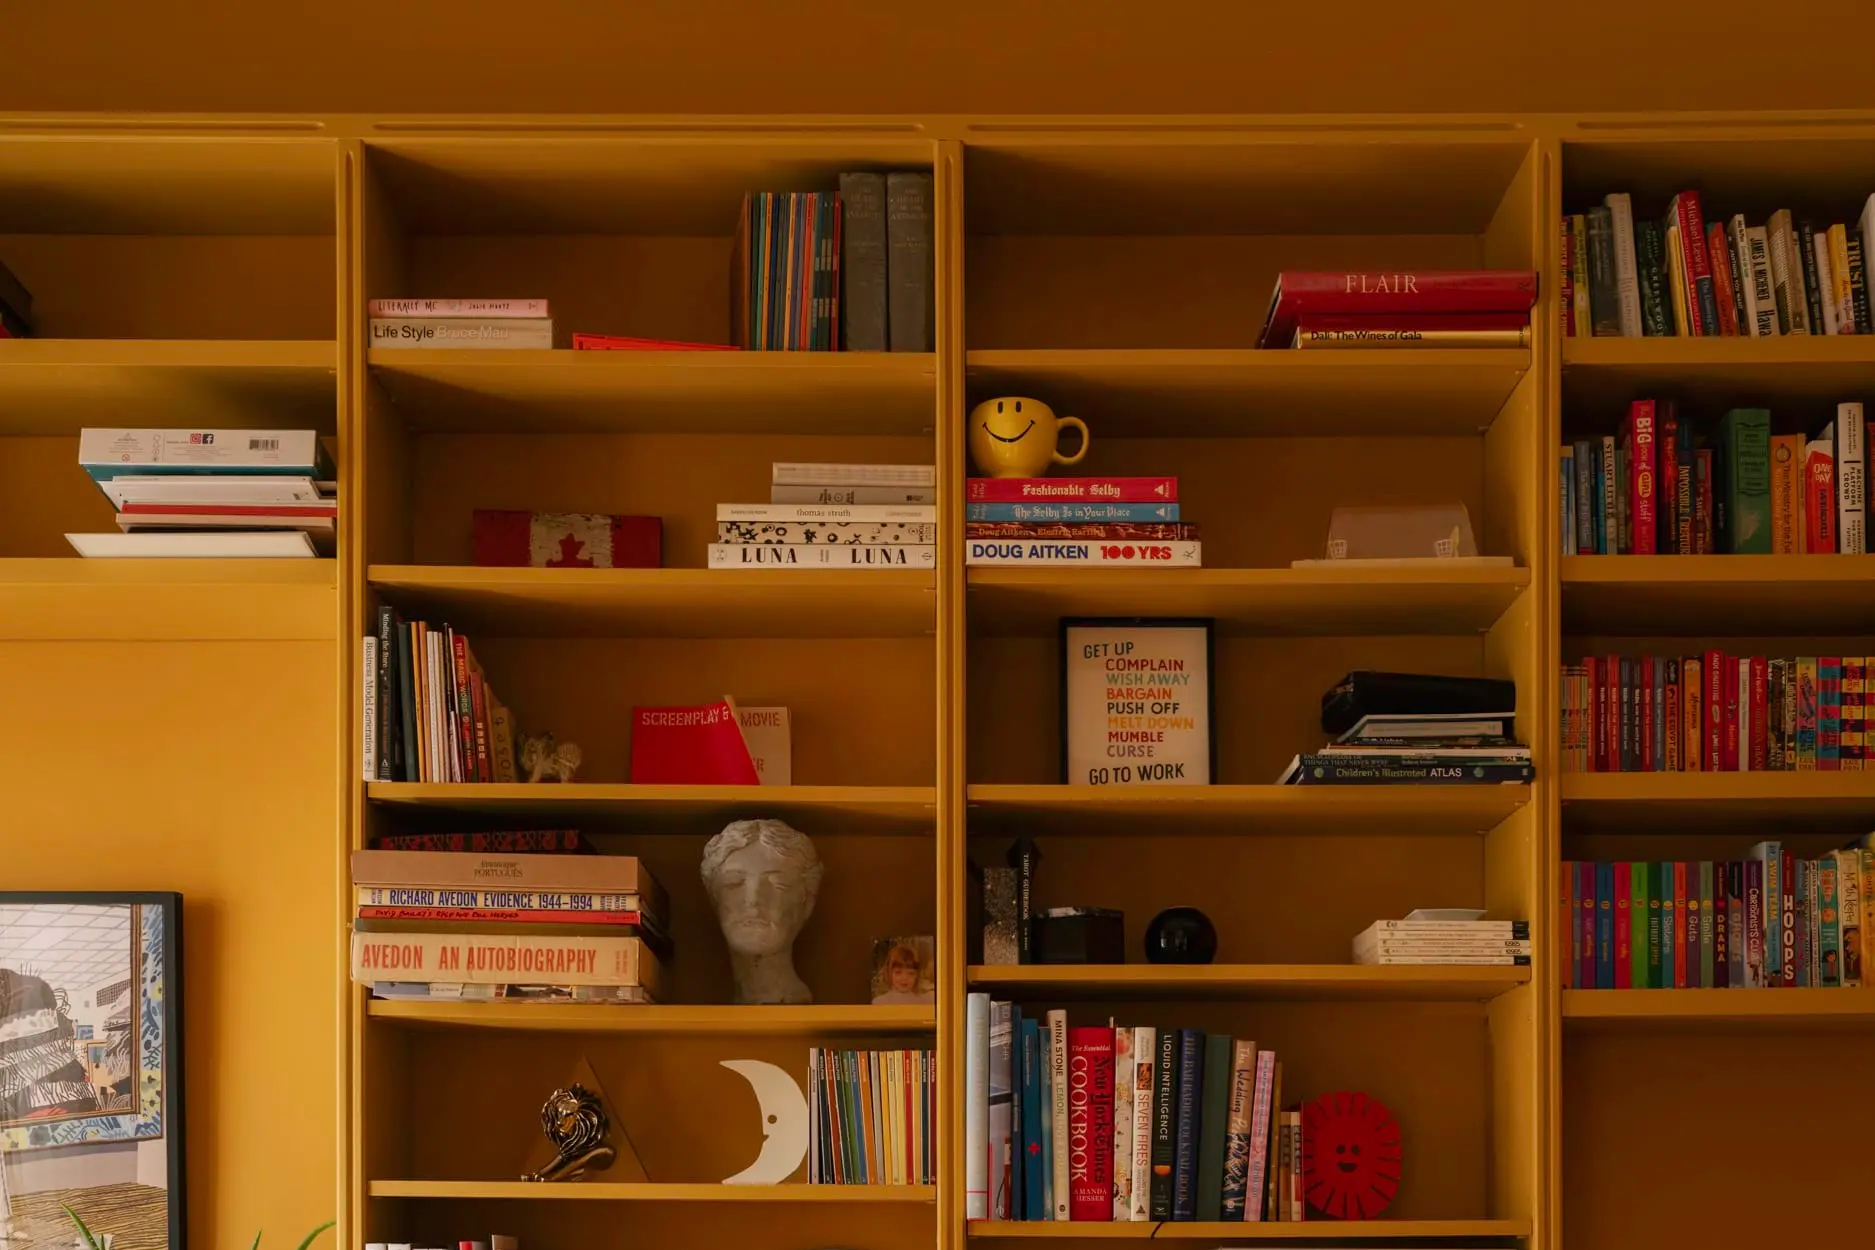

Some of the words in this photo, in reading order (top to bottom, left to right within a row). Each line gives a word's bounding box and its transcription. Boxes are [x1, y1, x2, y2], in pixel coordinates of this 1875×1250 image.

[1686, 199, 1701, 241] Michael
[1750, 238, 1766, 260] JAMES
[1345, 274, 1419, 293] FLAIR
[1754, 269, 1770, 301] MICHENER
[425, 301, 438, 312] ME
[374, 326, 398, 338] Life
[401, 325, 434, 341] Style
[437, 326, 480, 338] Bruce
[1335, 331, 1354, 341] The
[1355, 331, 1386, 341] Wines
[1388, 330, 1398, 341] of
[1400, 331, 1422, 341] Gala
[1605, 443, 1614, 482] STUART
[1022, 483, 1084, 495] Fashionable
[1089, 483, 1120, 499] Selby
[1606, 484, 1616, 516] LITTLE
[1679, 465, 1691, 514] IMPOSSIBLE
[796, 508, 825, 517] thomas
[828, 509, 851, 517] struth
[1012, 506, 1030, 519] The
[1032, 506, 1059, 519] Selby
[1075, 506, 1082, 518] in
[1083, 506, 1105, 519] Your
[1106, 505, 1130, 518] Place
[979, 529, 999, 537] Doug
[1001, 529, 1028, 537] Aitken
[742, 548, 797, 563] LUNA
[851, 548, 907, 564] LUNA
[972, 544, 1022, 559] DOUG
[1028, 545, 1088, 559] AITKEN
[1101, 546, 1135, 559] 100
[1138, 546, 1171, 559] YRS
[380, 613, 390, 640] Minding
[365, 642, 374, 678] Business
[455, 642, 464, 656] THE
[1084, 643, 1109, 659] GET
[1114, 642, 1134, 656] UP
[457, 659, 466, 682] MAGIC
[1105, 658, 1184, 671] COMPLAIN
[1106, 673, 1143, 685] WISH
[1147, 673, 1190, 685] AWAY
[366, 680, 375, 711] Model
[459, 684, 469, 712] WORDS
[1106, 687, 1172, 700] BARGAIN
[641, 707, 720, 727] SCREENPLAY
[740, 712, 781, 727] MOVIE
[1107, 702, 1144, 715] PUSH
[1151, 702, 1180, 715] OFF
[366, 713, 375, 754] Generation
[1107, 717, 1143, 729] MELT
[1148, 717, 1194, 729] DOWN
[1108, 731, 1164, 743] MUMBLE
[1107, 745, 1155, 758] CURSE
[1089, 768, 1108, 785] GO
[1113, 766, 1131, 783] TO
[1137, 763, 1185, 781] WORK
[1336, 767, 1380, 777] Children's
[1382, 767, 1427, 777] Illustrated
[1430, 768, 1462, 777] ATLAS
[1769, 860, 1777, 887] SWIM
[389, 889, 434, 906] RICHARD
[438, 890, 478, 908] AVEDON
[484, 892, 533, 908] EVIDENCE
[1769, 892, 1777, 919] TEAM
[1663, 916, 1672, 953] Sisters
[1688, 915, 1698, 942] Guts
[1703, 915, 1712, 944] Smile
[1717, 914, 1725, 962] DRAMA
[1784, 895, 1794, 980] HOOPS
[361, 944, 423, 968] AVEDON
[438, 946, 460, 971] AN
[466, 946, 597, 973] AUTOBIOGRAPHY
[1055, 1020, 1063, 1044] MINA
[1161, 1034, 1172, 1069] LIQUID
[1184, 1036, 1196, 1057] THE
[1238, 1048, 1250, 1064] The
[1055, 1046, 1063, 1077] STONE
[1093, 1055, 1112, 1089] New
[1056, 1083, 1064, 1117] LEMON,
[1231, 1069, 1250, 1113] Wedding
[1090, 1093, 1111, 1132] York
[1137, 1094, 1149, 1130] SEVEN
[1159, 1071, 1171, 1141] INTELLIGENCE
[1093, 1135, 1112, 1183] Times
[1136, 1134, 1149, 1166] FIRES
[1179, 1170, 1190, 1203] BOOK
